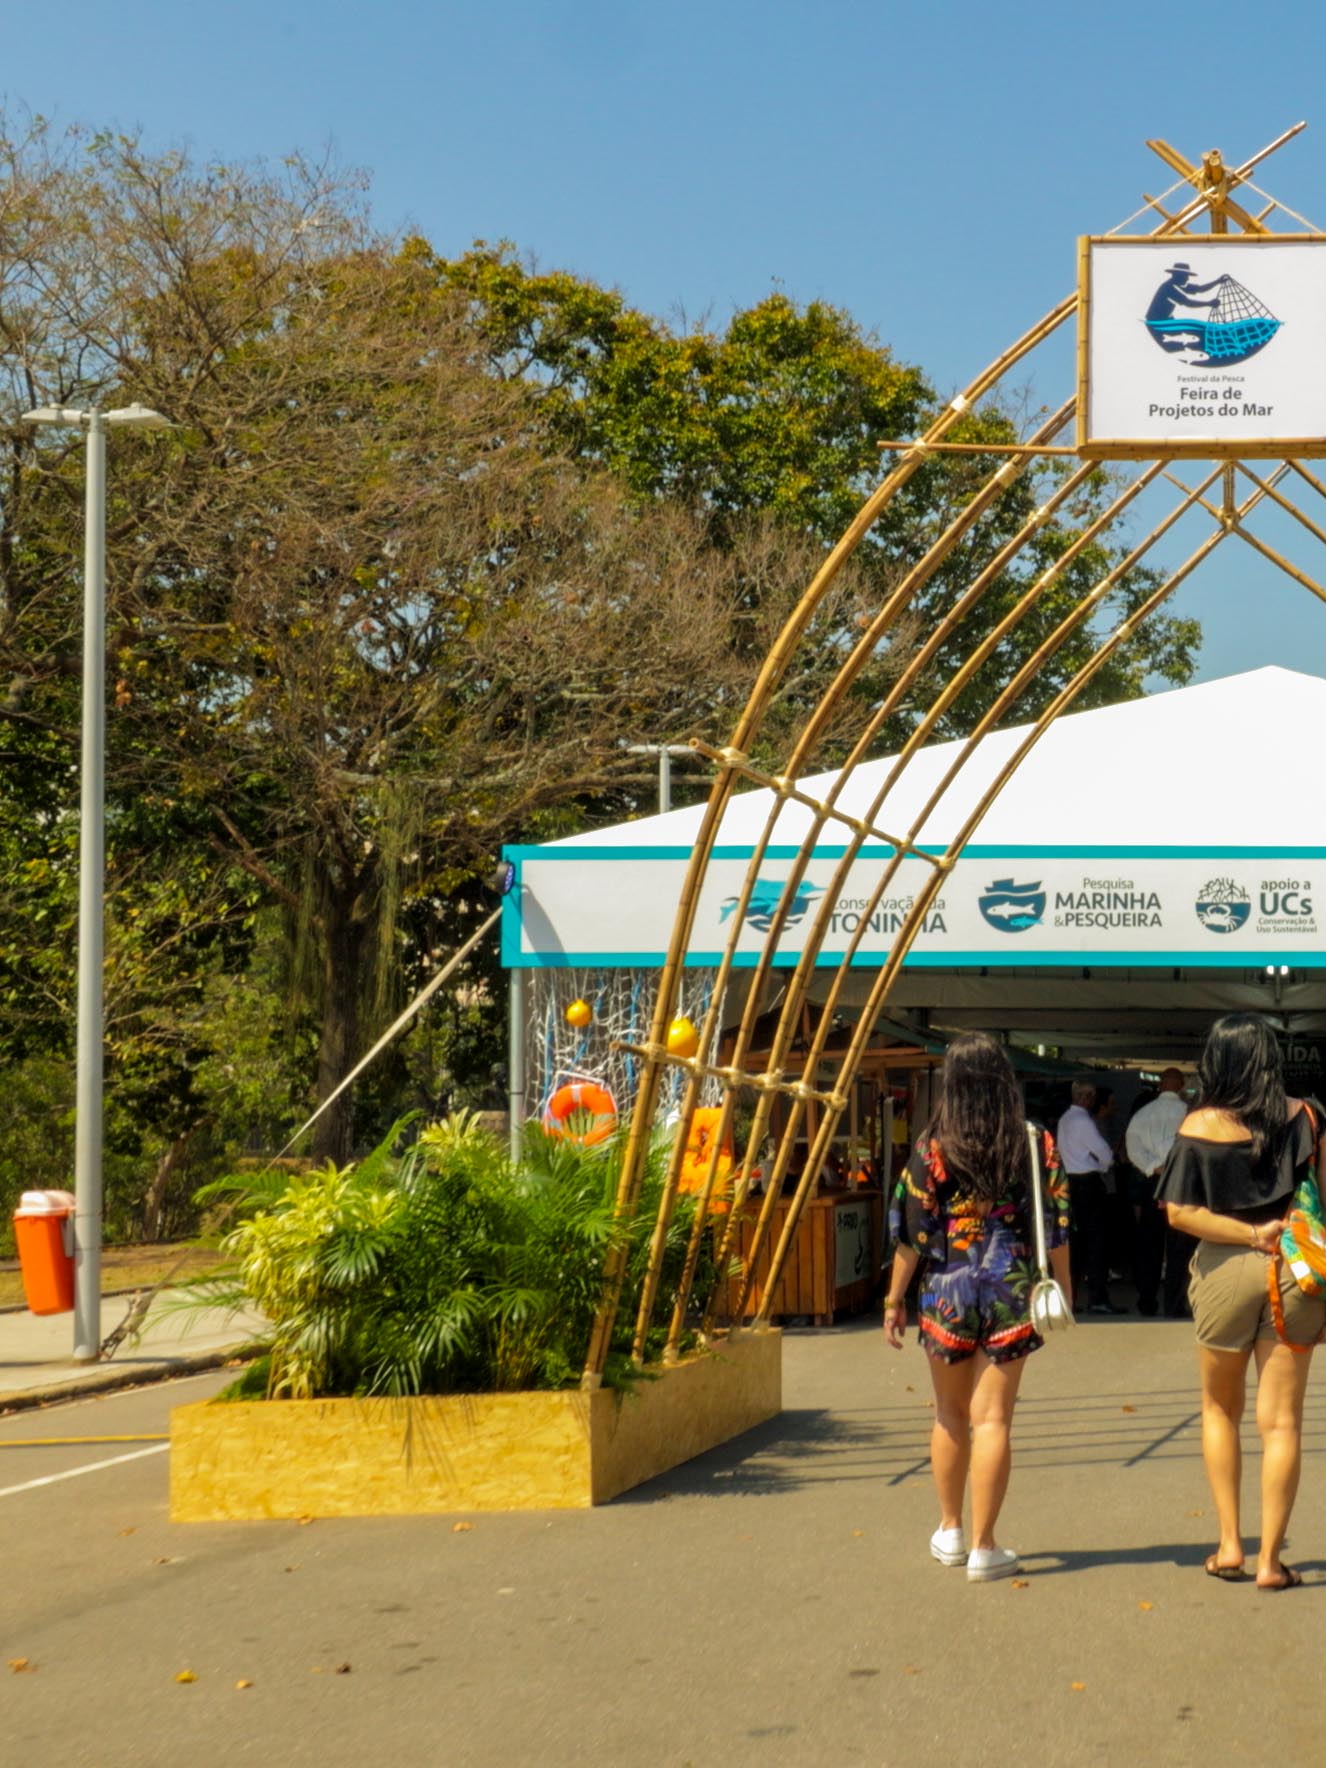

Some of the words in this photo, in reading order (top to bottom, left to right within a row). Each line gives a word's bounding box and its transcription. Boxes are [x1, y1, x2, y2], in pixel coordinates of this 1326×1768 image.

[1176, 375, 1209, 383] Festival
[1210, 375, 1221, 383] da
[1222, 375, 1246, 383] Pesca
[1180, 387, 1219, 400] Feira
[1222, 387, 1243, 400] de
[1149, 403, 1215, 420] Projetos
[1218, 403, 1239, 417] do
[1242, 403, 1274, 417] Mar
[1083, 877, 1135, 892] Pesquisa
[1261, 877, 1300, 893] apoio
[1303, 880, 1312, 891] a
[1055, 891, 1162, 911] MARINHA
[1260, 892, 1313, 916] UCs
